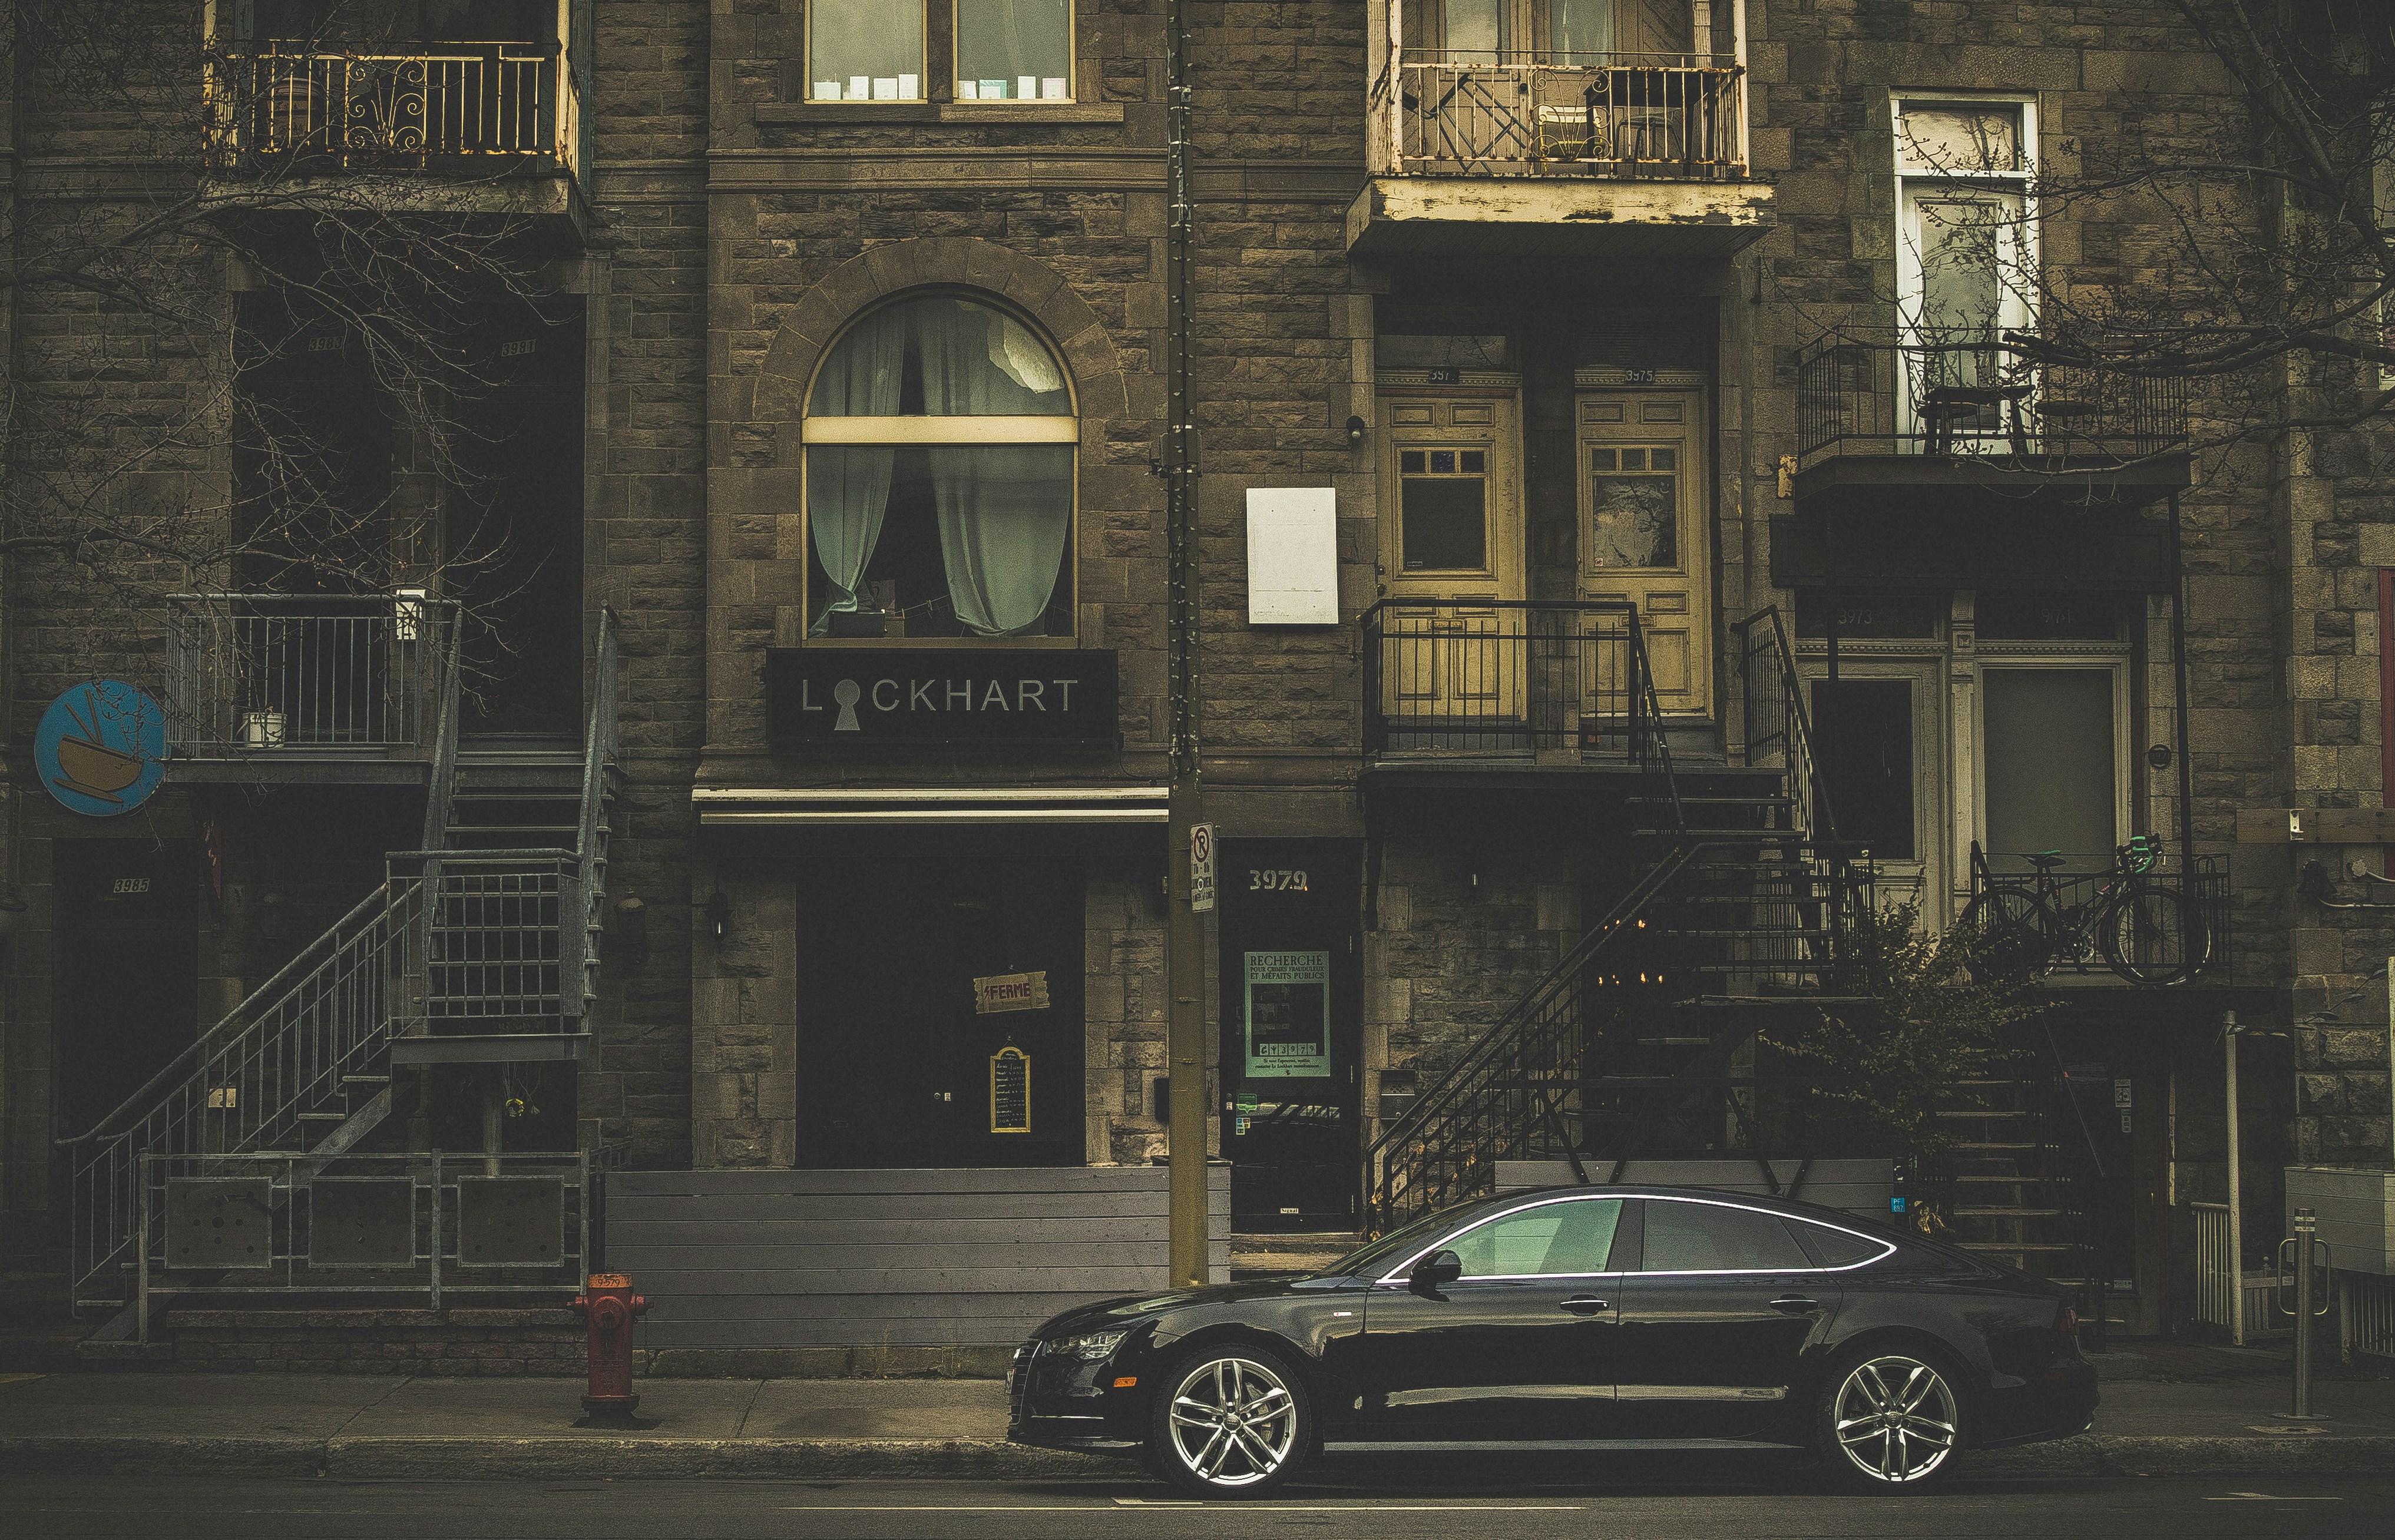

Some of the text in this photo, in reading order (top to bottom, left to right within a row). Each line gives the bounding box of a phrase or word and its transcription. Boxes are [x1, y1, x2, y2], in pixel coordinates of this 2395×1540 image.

[1838, 609, 1872, 624] 3973
[114, 879, 149, 892] 3985
[1249, 869, 1307, 890] 3979
[1250, 953, 1323, 966] RECHERCHÉ
[1261, 971, 1292, 979] MÉFAITS
